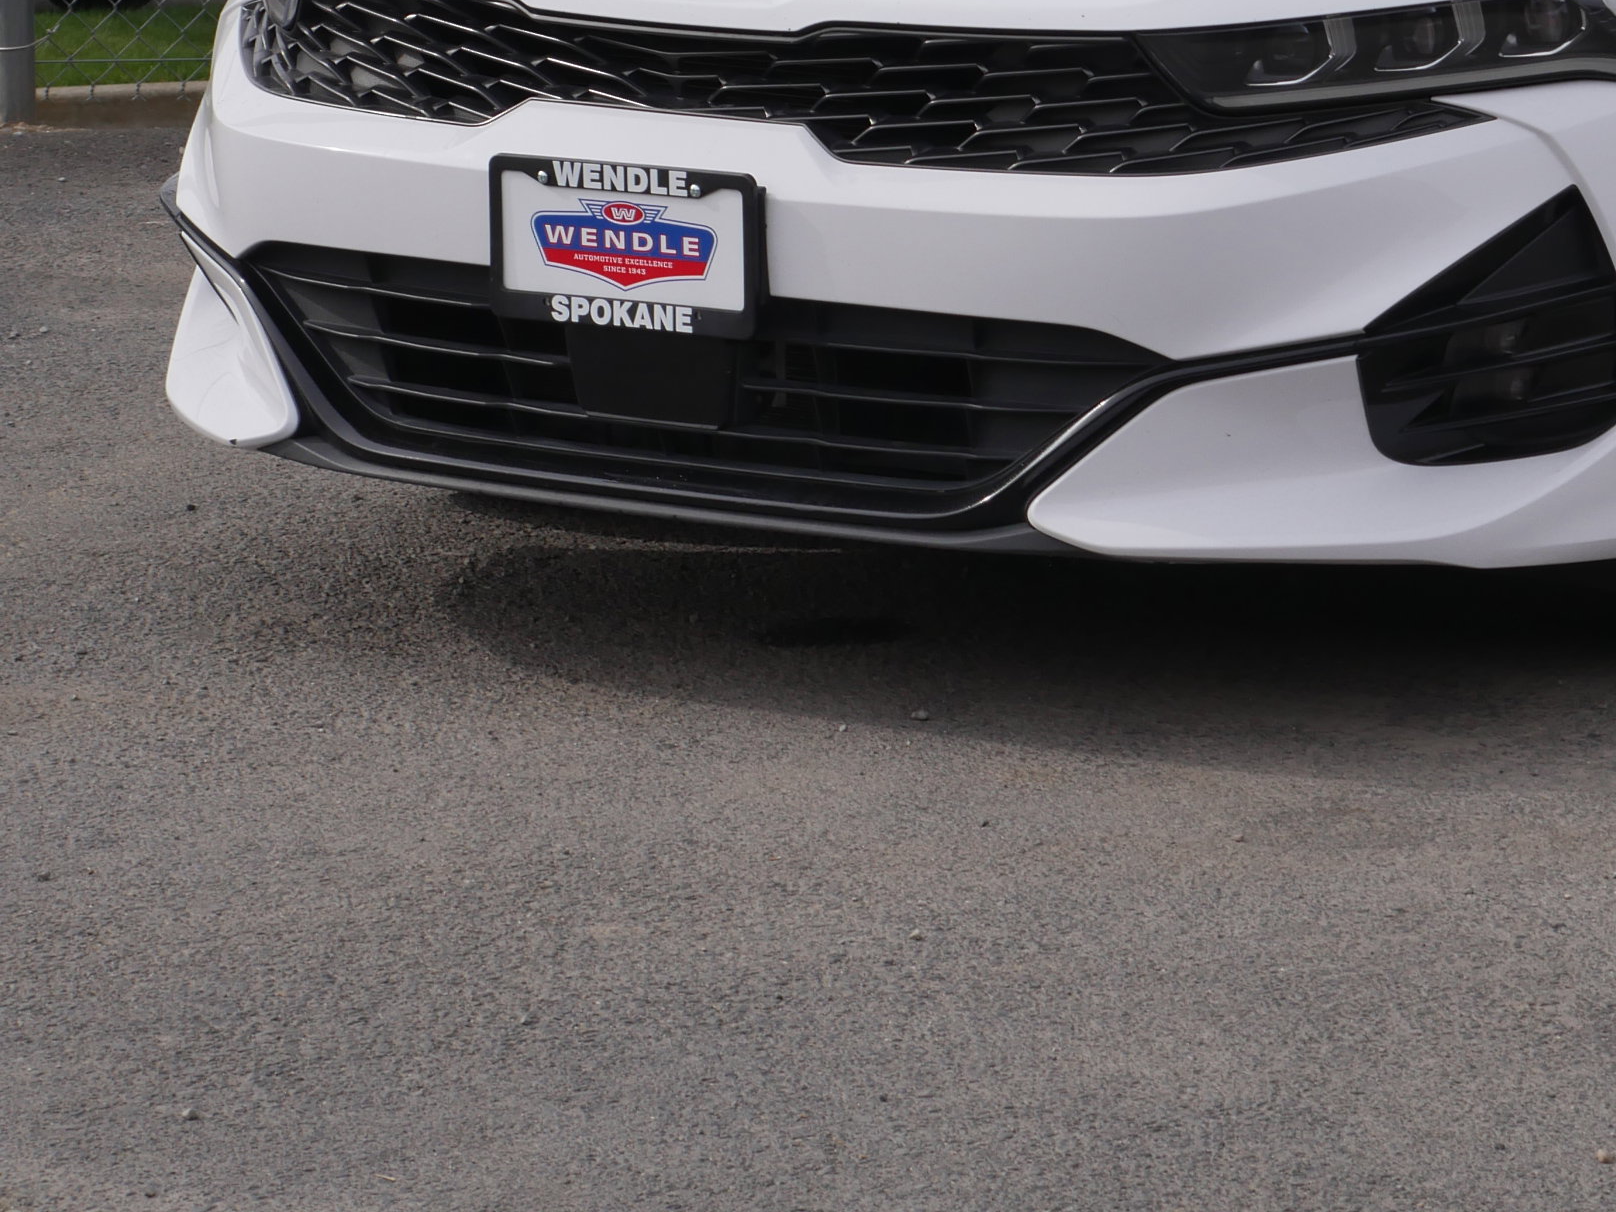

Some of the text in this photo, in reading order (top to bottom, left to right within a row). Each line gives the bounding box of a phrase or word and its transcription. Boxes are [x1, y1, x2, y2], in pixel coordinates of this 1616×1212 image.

[552, 160, 689, 198] WENDLE
[544, 224, 700, 256] WENDLE
[573, 253, 673, 269] AUTOMOTIVE EXCELLENCE
[603, 265, 627, 274] SINCE
[551, 294, 694, 334] SPOKANE
